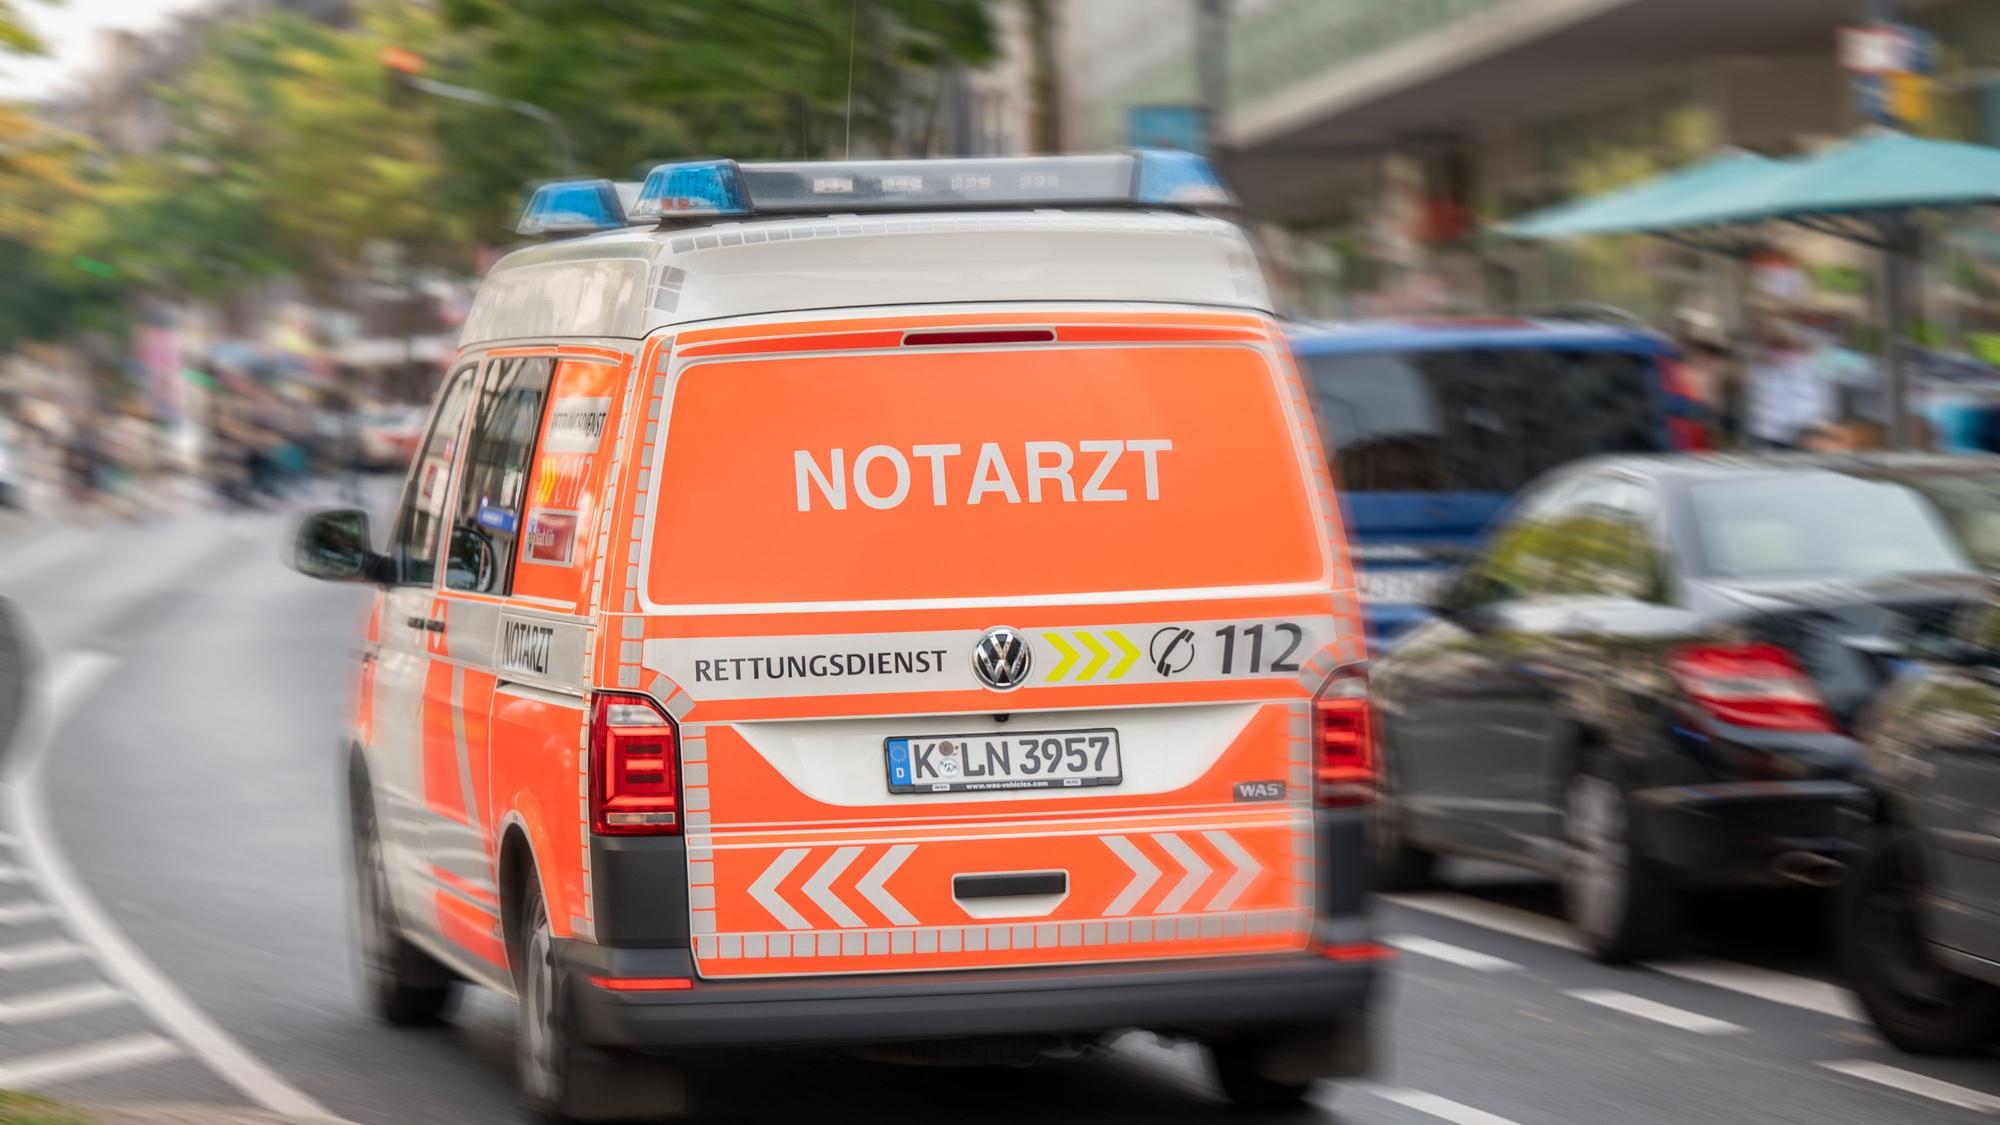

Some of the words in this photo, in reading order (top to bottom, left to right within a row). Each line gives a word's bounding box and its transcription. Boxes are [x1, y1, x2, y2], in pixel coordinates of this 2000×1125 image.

[794, 439, 1173, 512] NOTARZT
[502, 620, 554, 675] NOTARZT
[694, 649, 948, 683] RETTUNGSDIENST
[1215, 622, 1303, 675] 112
[913, 742, 940, 778] K
[961, 740, 1012, 776] LN
[1019, 736, 1110, 774] 3957
[966, 780, 1049, 790] www.was-vehicles.com
[1239, 783, 1279, 798] WAS
